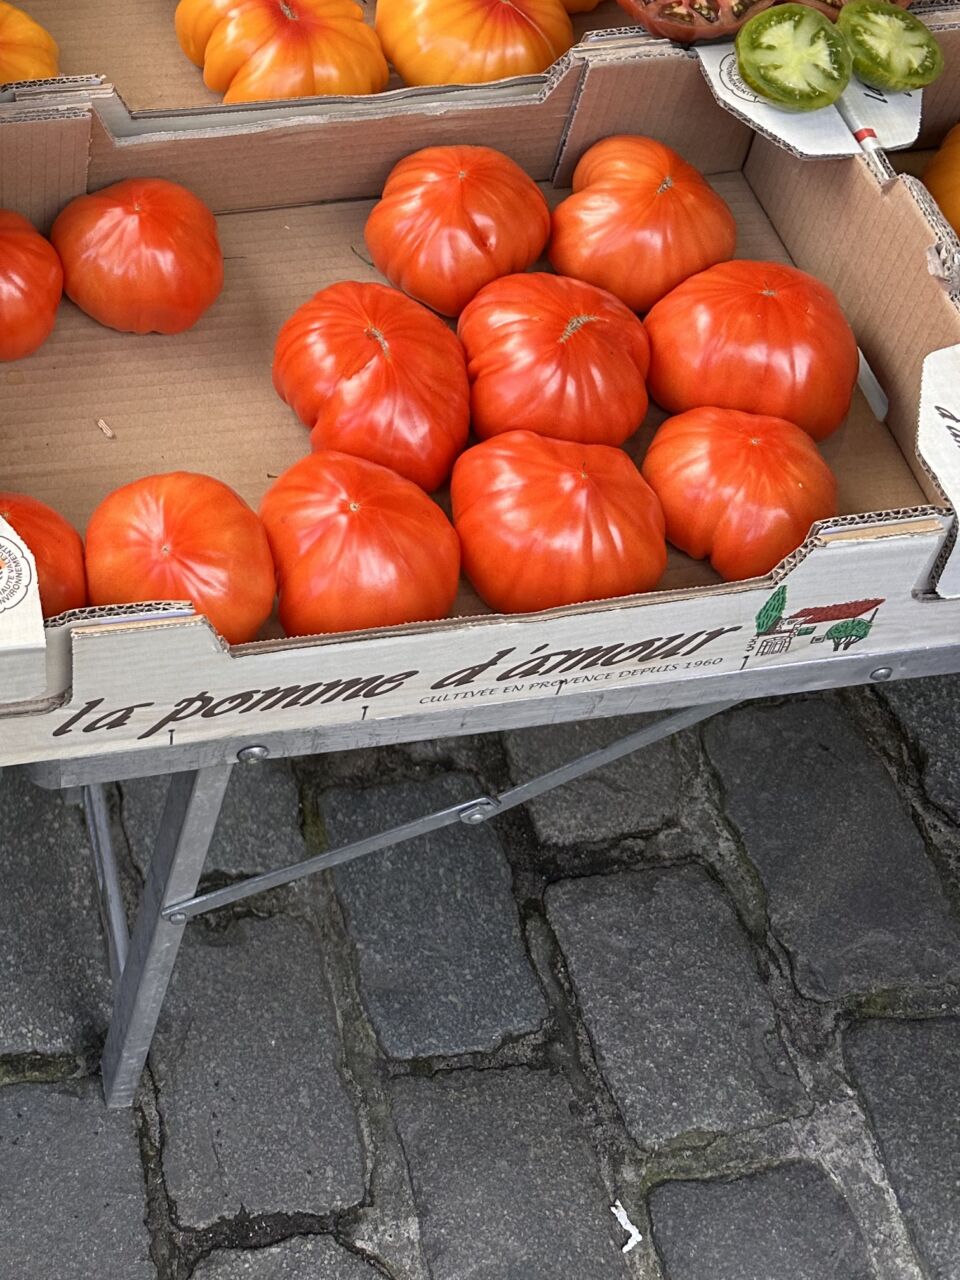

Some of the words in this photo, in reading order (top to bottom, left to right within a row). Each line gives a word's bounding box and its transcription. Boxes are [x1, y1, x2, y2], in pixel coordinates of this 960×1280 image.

[52, 697, 155, 737] la
[137, 670, 420, 740] pomme
[430, 625, 744, 690] d'amour
[419, 686, 497, 705] CULTIVÉE
[502, 684, 526, 694] EN
[528, 671, 614, 690] PROVENCE
[618, 663, 679, 680] DEPUIS
[683, 657, 725, 670] 1960
